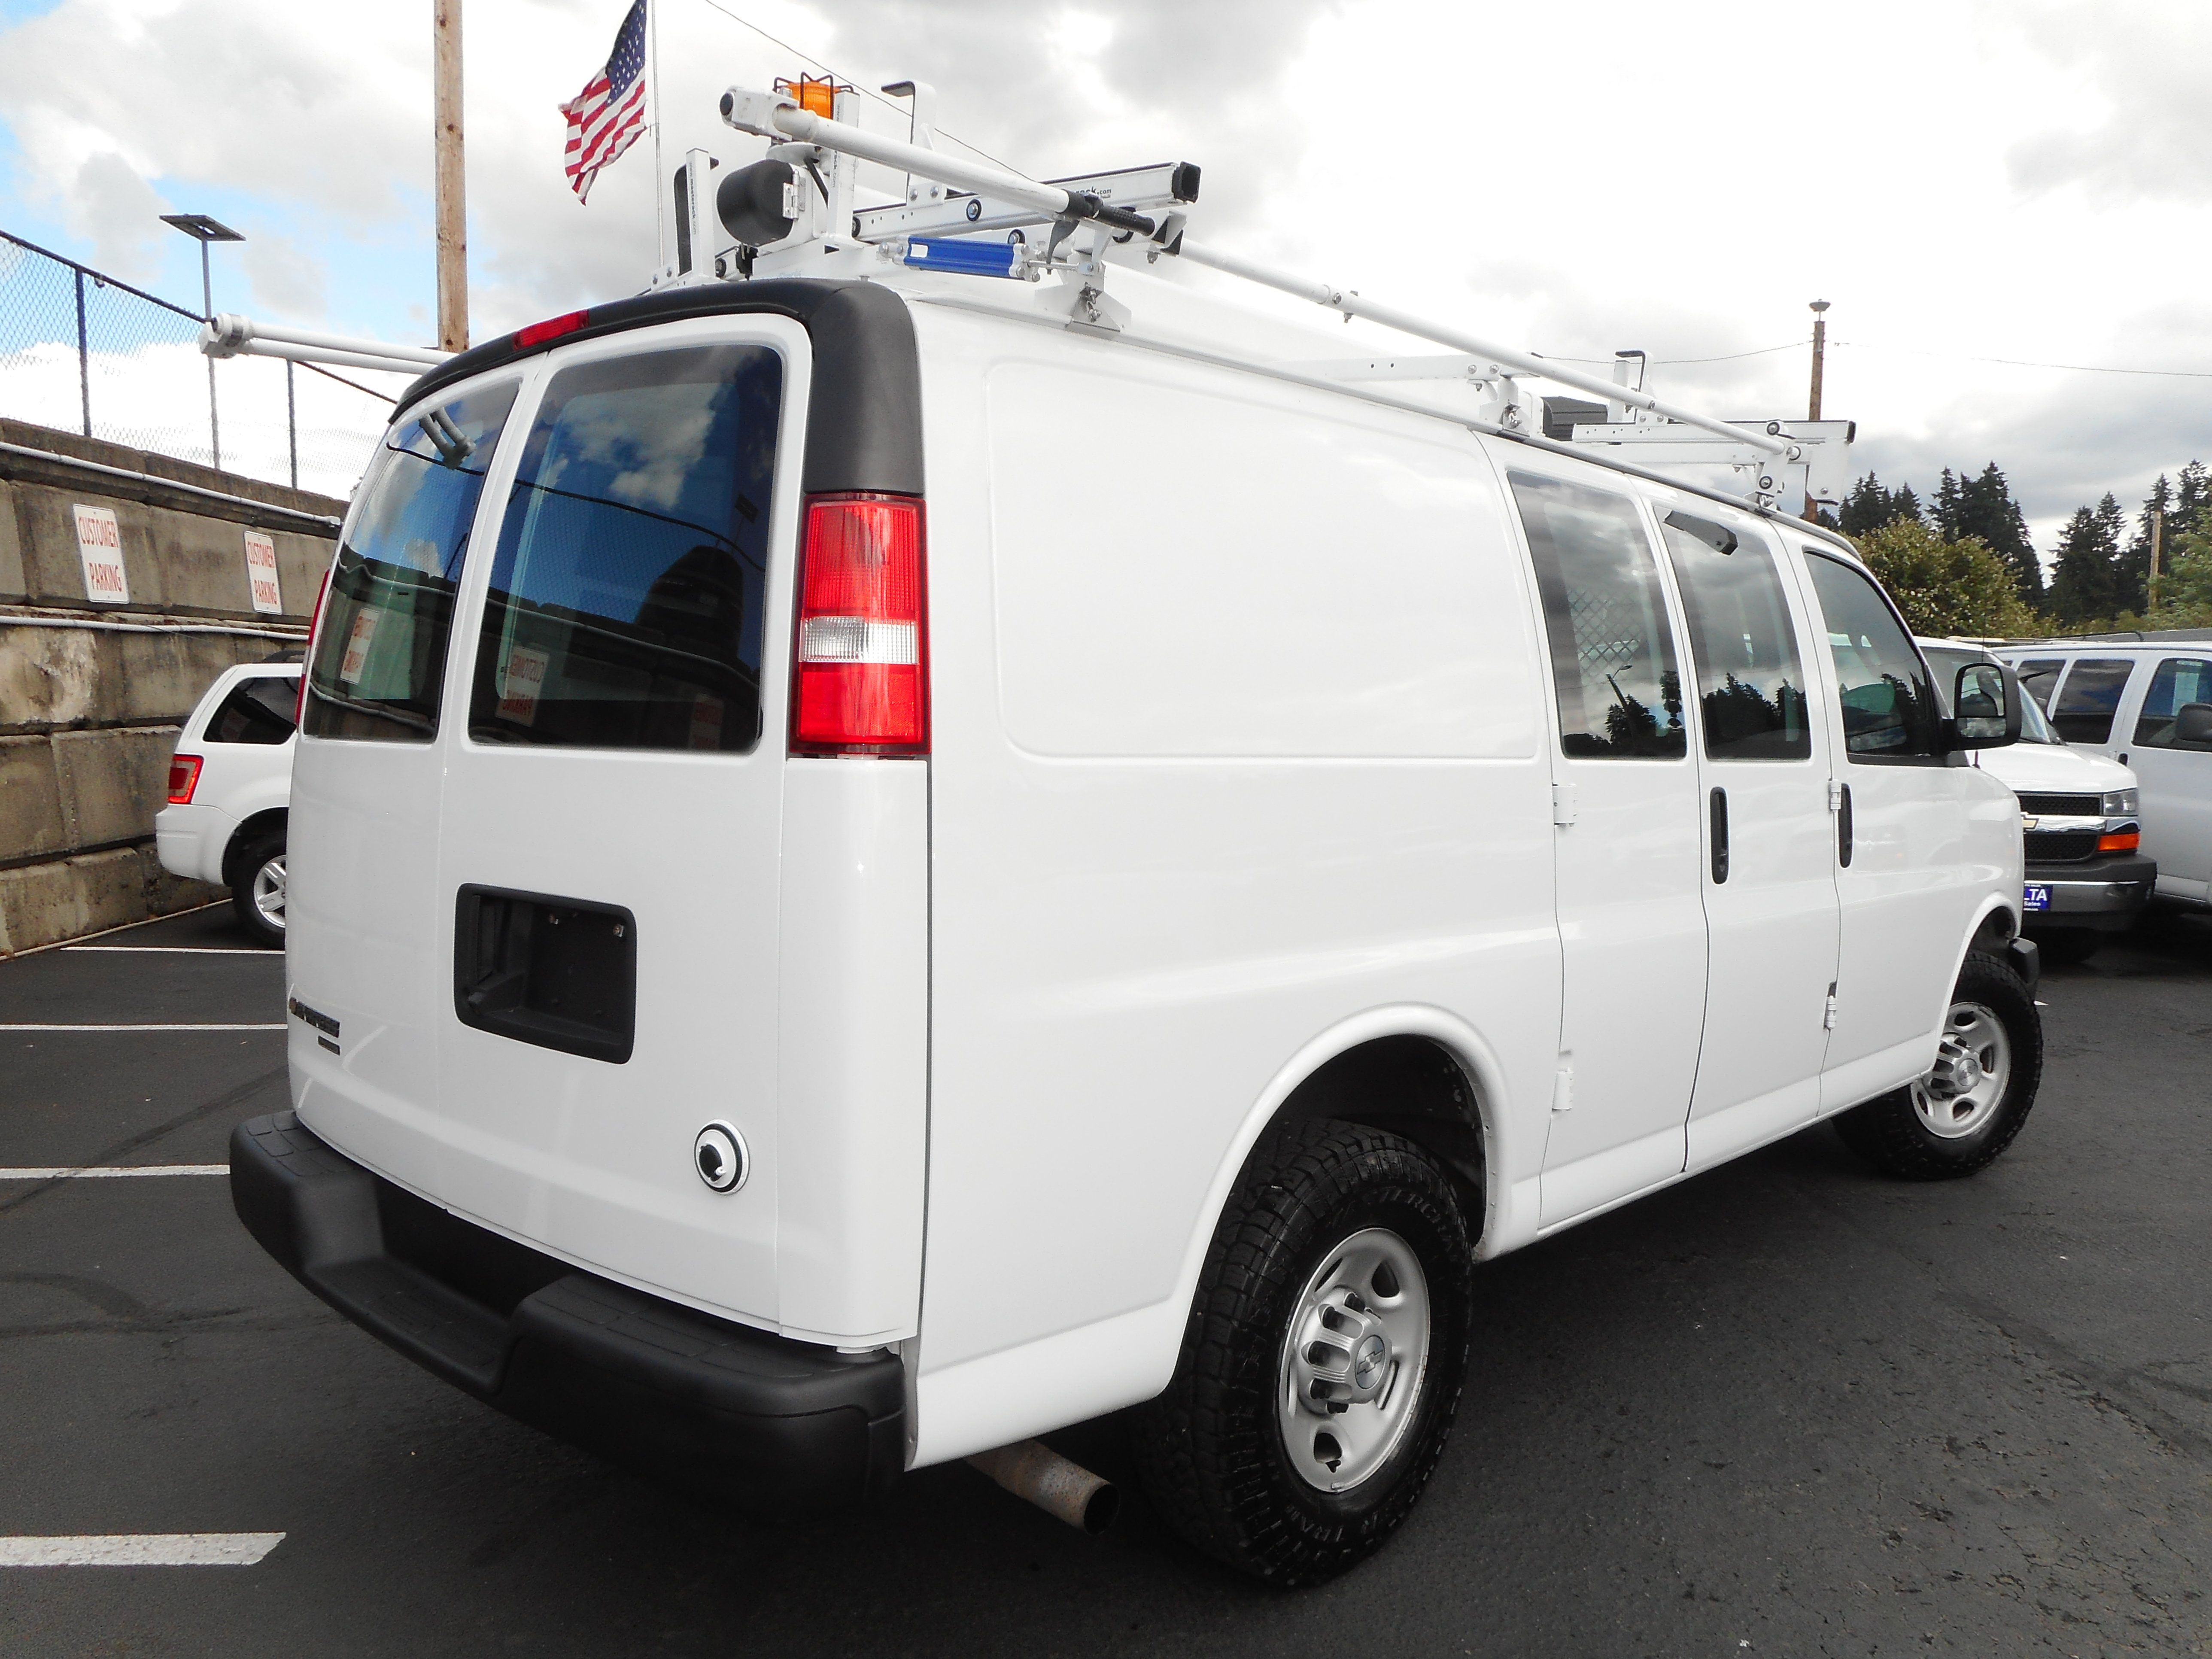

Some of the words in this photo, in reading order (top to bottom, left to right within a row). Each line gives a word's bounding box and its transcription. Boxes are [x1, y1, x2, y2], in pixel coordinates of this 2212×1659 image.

[79, 517, 118, 547] CUSTOMER
[248, 541, 275, 568] CUSTOMER
[89, 562, 122, 592] PARKING
[254, 579, 277, 605] PARKING
